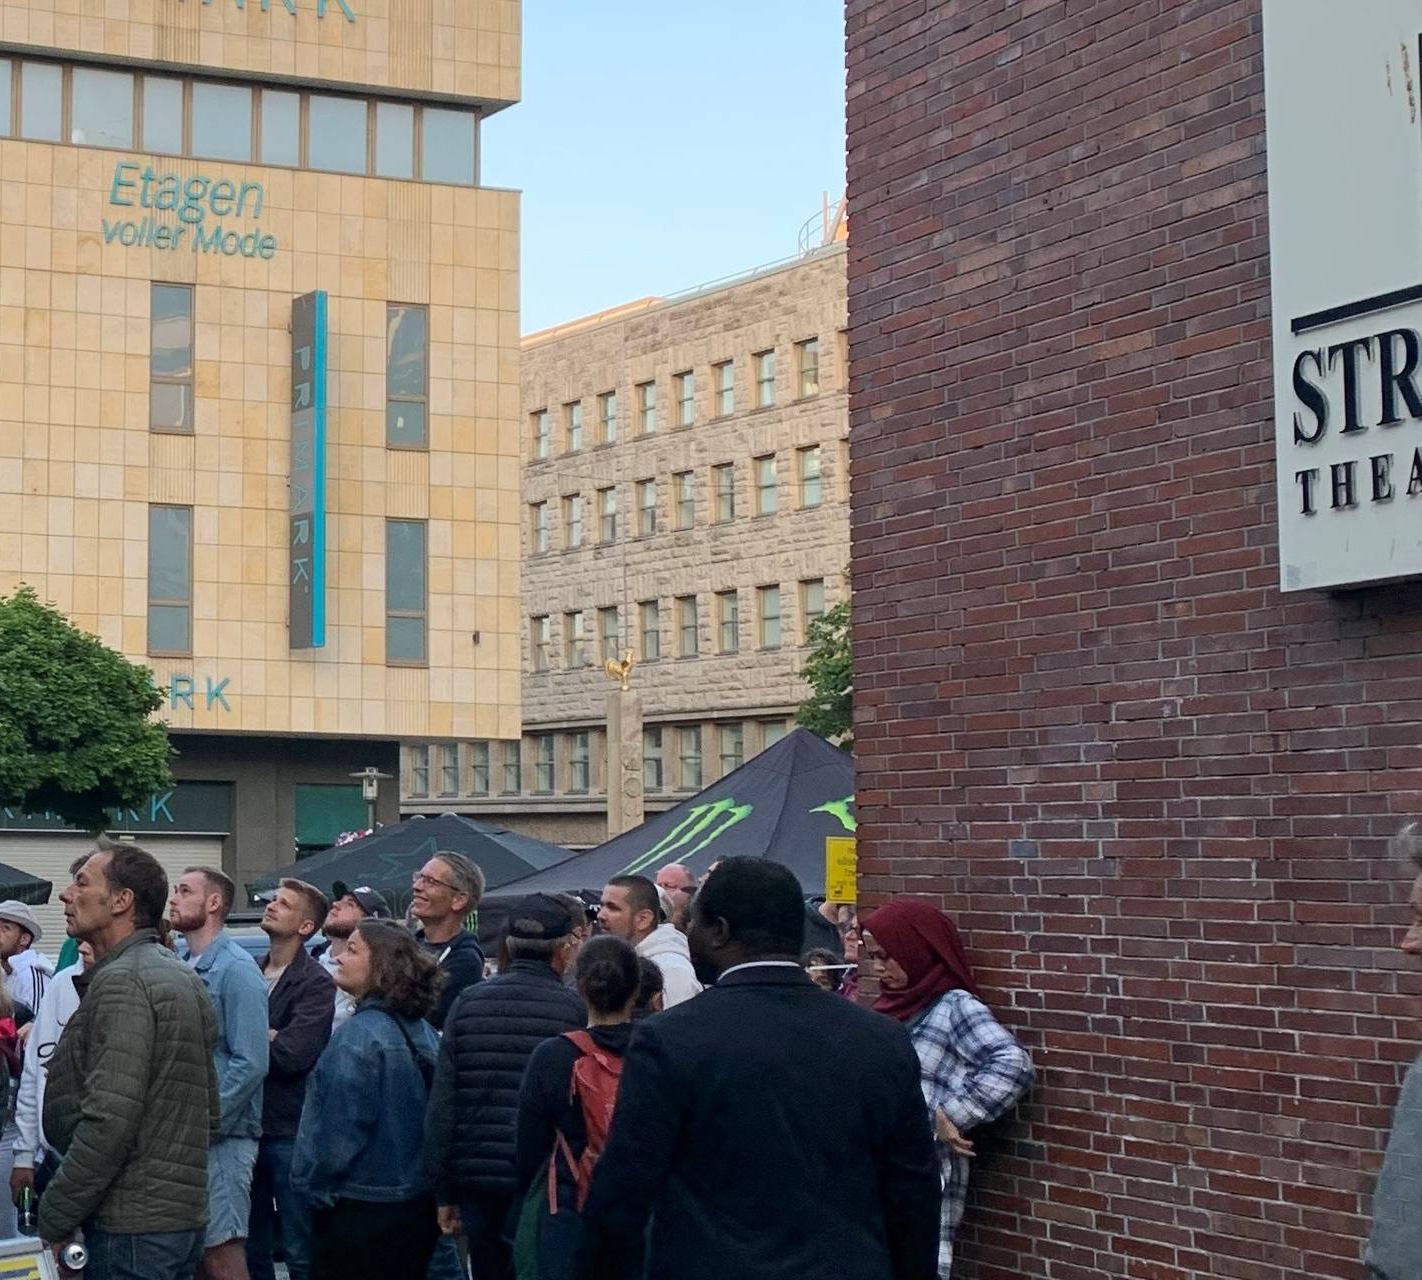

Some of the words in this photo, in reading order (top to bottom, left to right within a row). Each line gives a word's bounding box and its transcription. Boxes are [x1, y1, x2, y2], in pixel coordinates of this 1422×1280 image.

[110, 161, 265, 224] Etagen
[101, 216, 186, 250] voller
[192, 224, 278, 260] Mode
[293, 345, 311, 585] PRIMARK
[169, 673, 231, 712] RK
